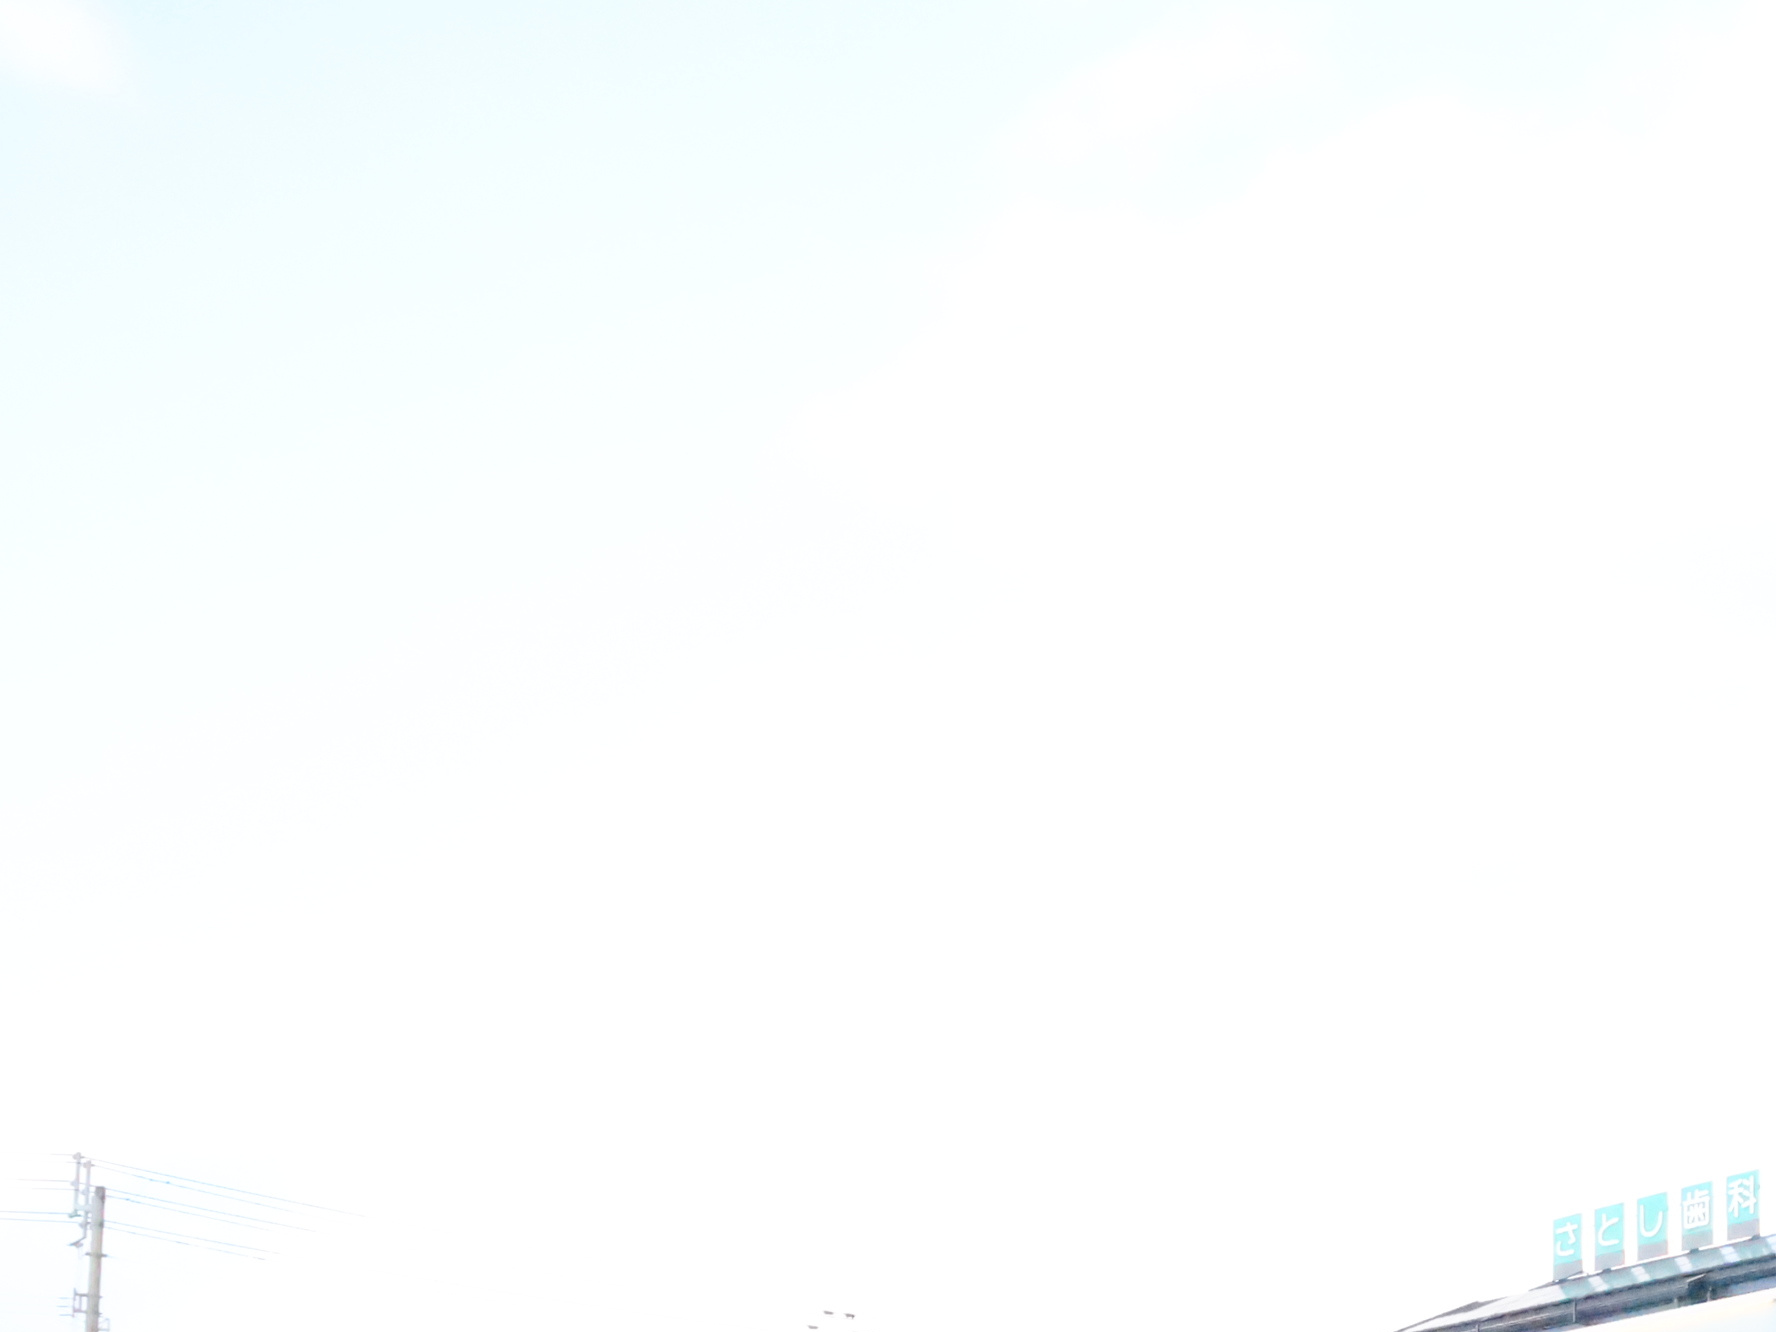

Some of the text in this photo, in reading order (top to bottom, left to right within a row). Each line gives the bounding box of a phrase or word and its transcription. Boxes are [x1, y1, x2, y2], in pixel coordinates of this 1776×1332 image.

[1555, 1176, 1758, 1257] さとし歯科
